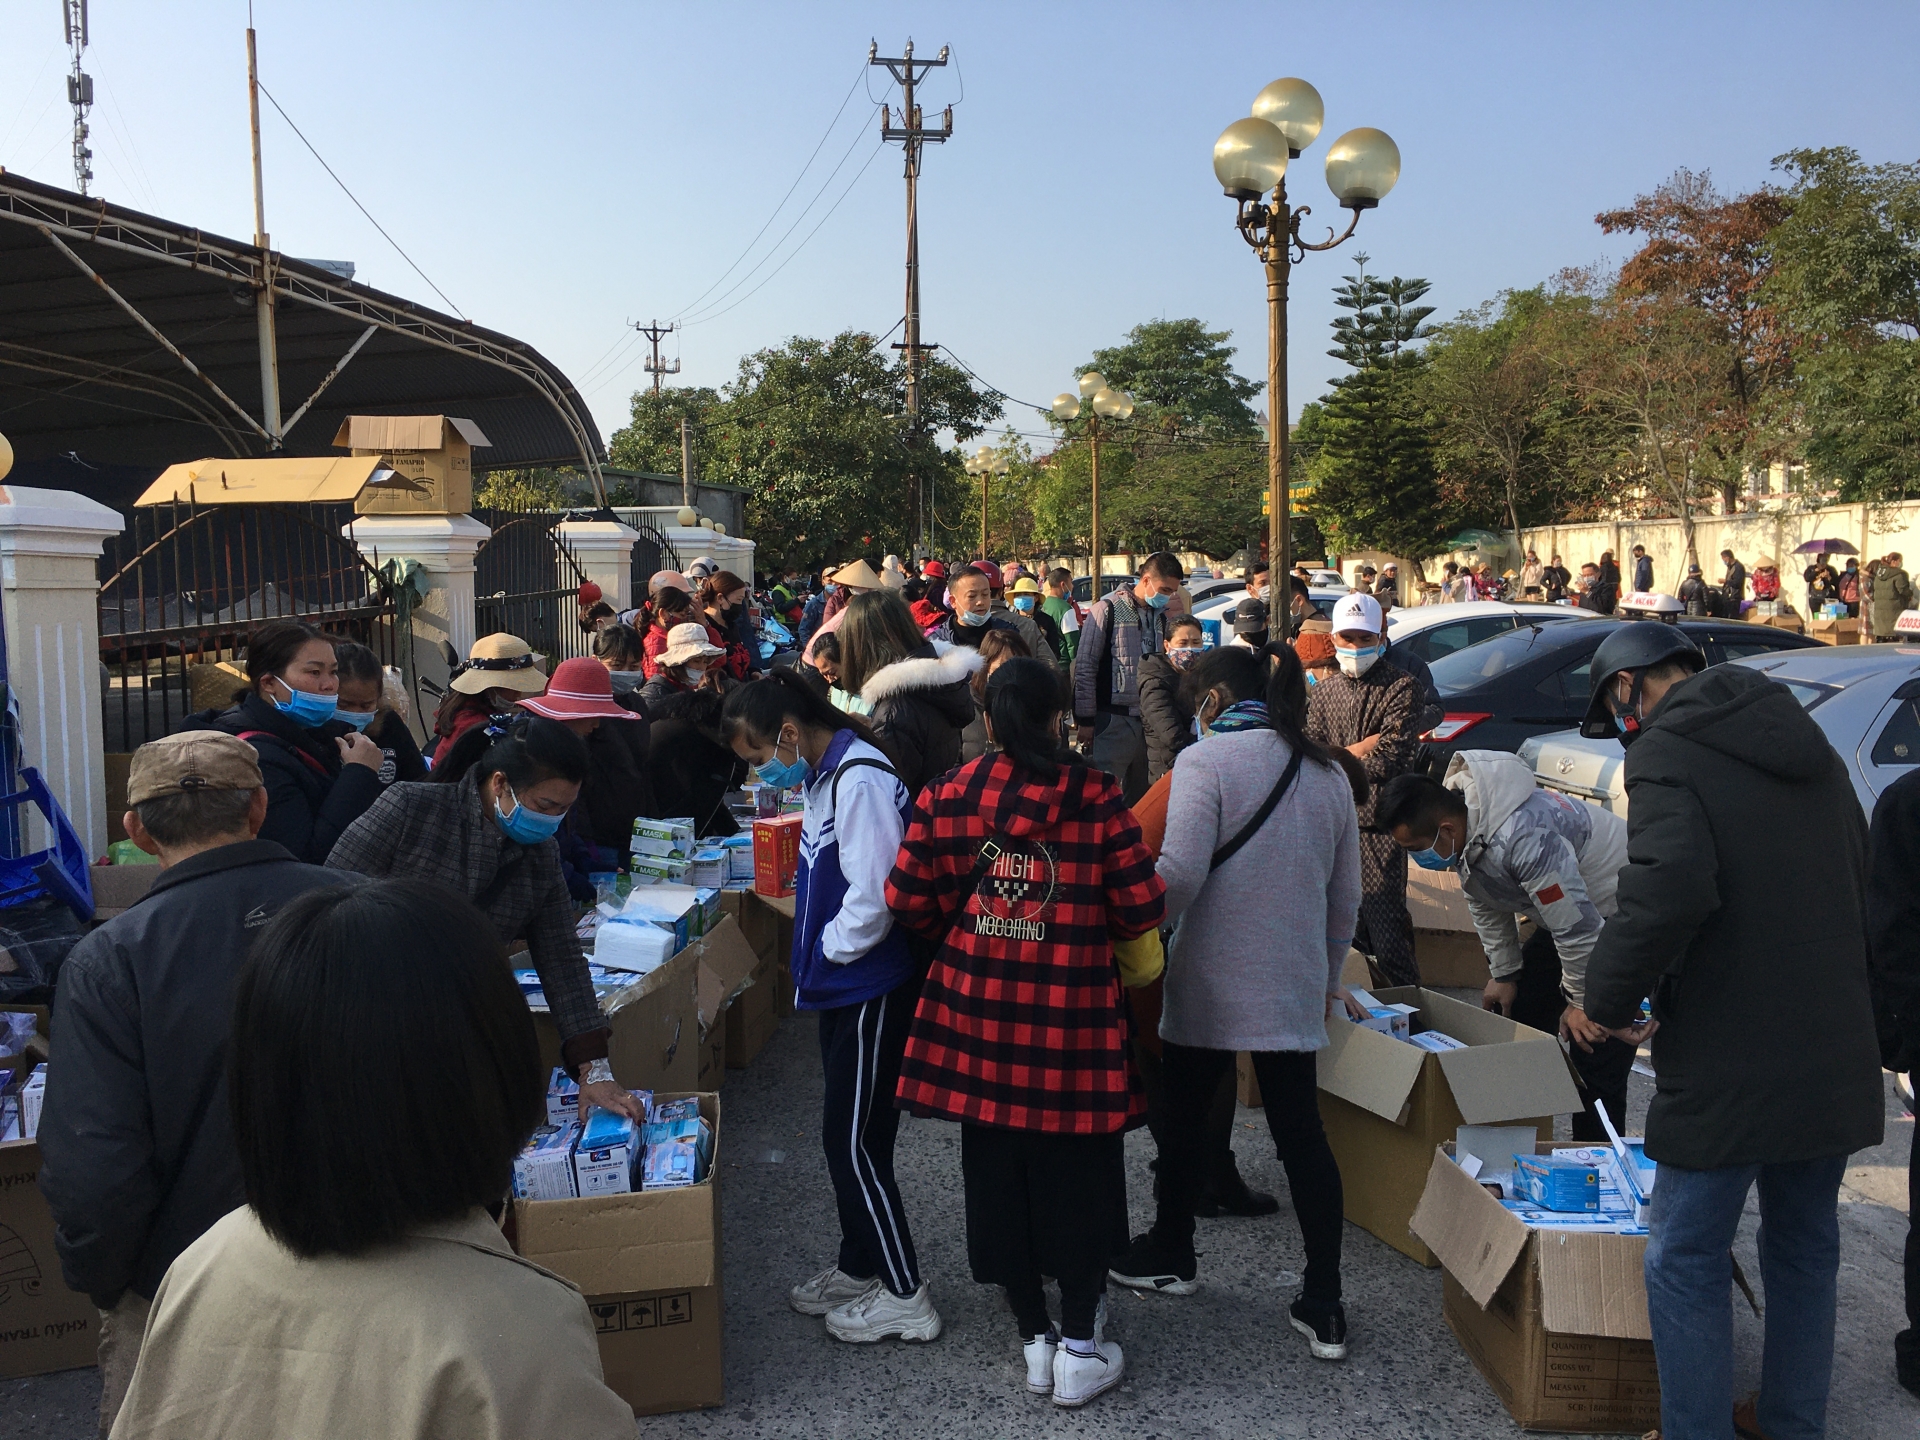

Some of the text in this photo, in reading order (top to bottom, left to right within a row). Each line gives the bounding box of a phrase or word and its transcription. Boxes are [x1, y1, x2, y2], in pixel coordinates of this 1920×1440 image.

[642, 829, 665, 839] MASK
[992, 852, 1035, 880] HIGH
[639, 866, 661, 877] MASK
[0, 1171, 37, 1191] KHẨ
[0, 1319, 88, 1342] KHẨU TRAN
[1551, 1342, 1593, 1351] QUANTITY
[1550, 1363, 1576, 1371] GROSS
[1550, 1383, 1572, 1391] MEAS
